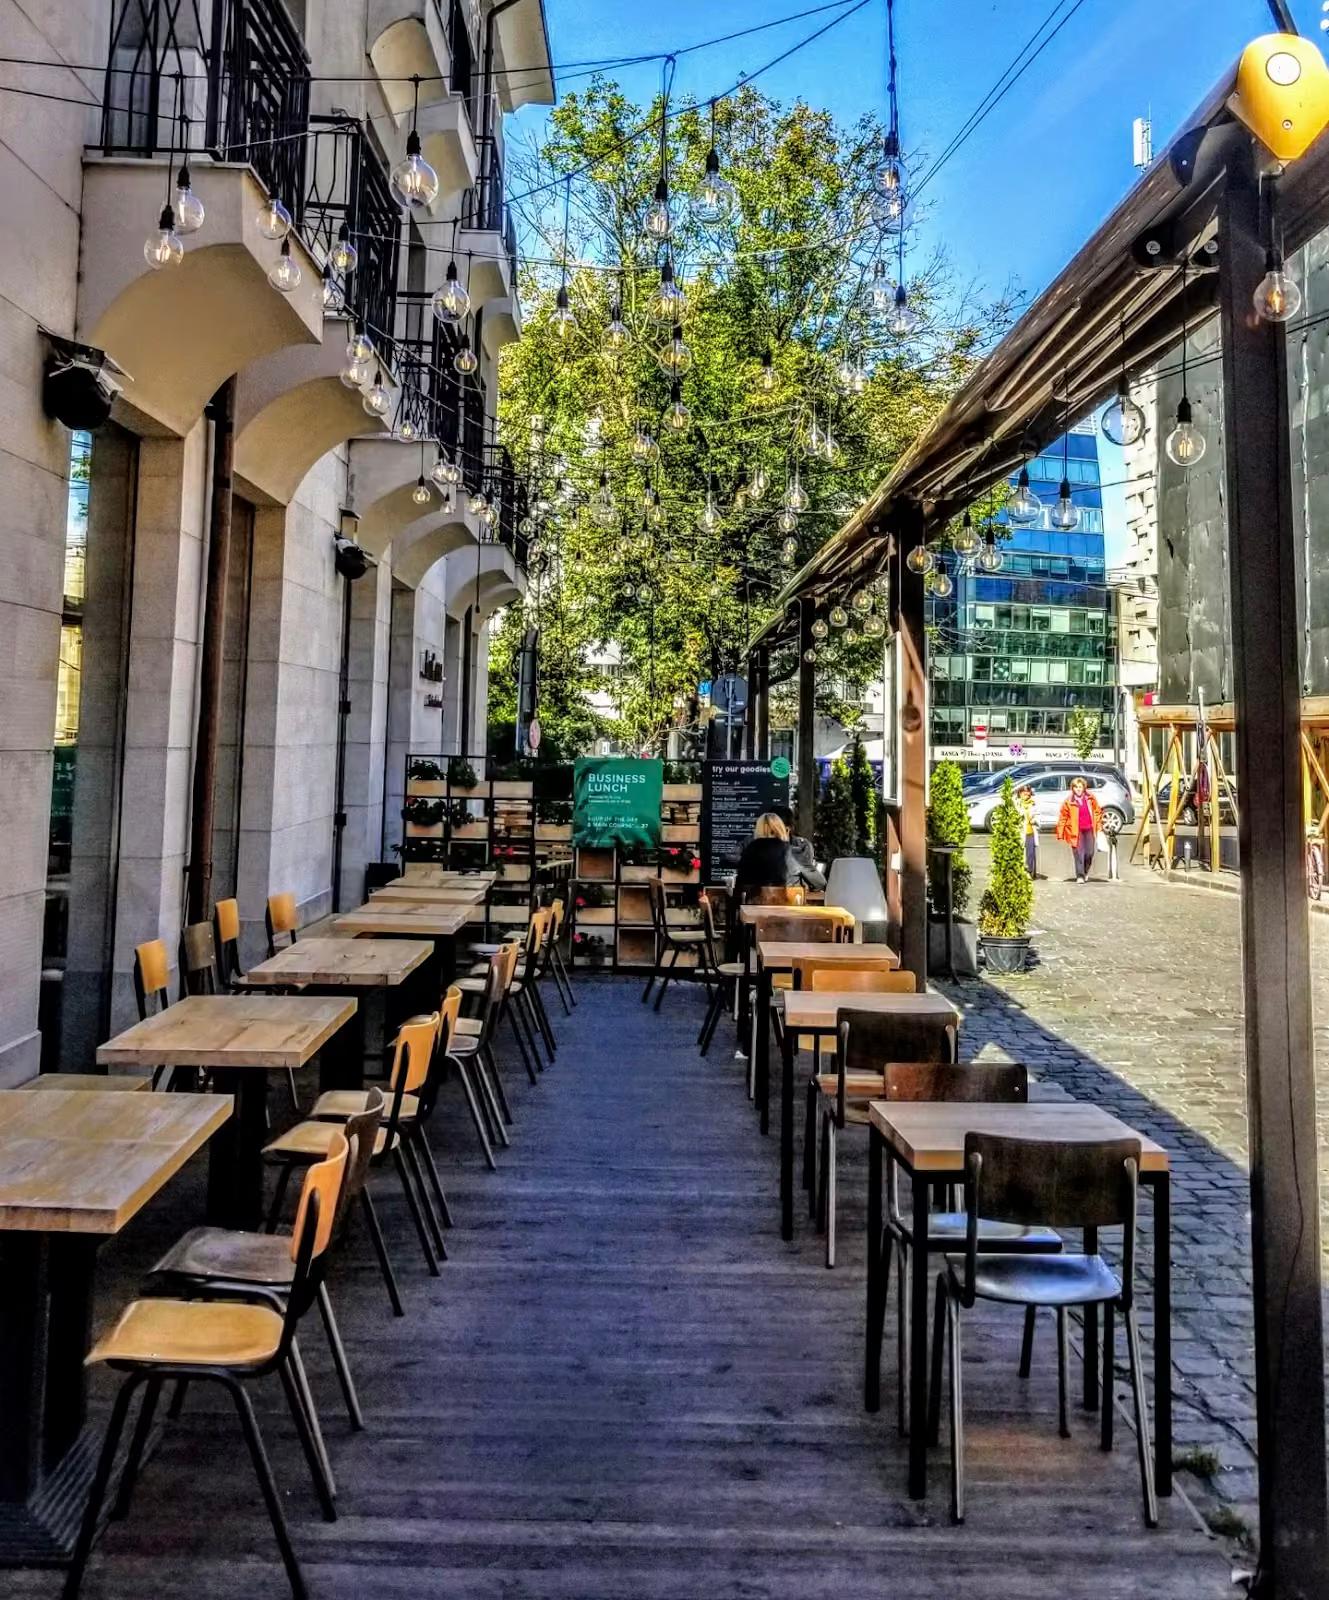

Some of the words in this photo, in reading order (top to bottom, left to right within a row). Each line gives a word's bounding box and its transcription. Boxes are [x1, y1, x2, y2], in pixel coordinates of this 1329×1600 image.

[712, 766, 723, 774] try
[740, 766, 771, 774] goodies
[588, 773, 646, 783] BUSINESS
[588, 783, 628, 793] LUNCH
